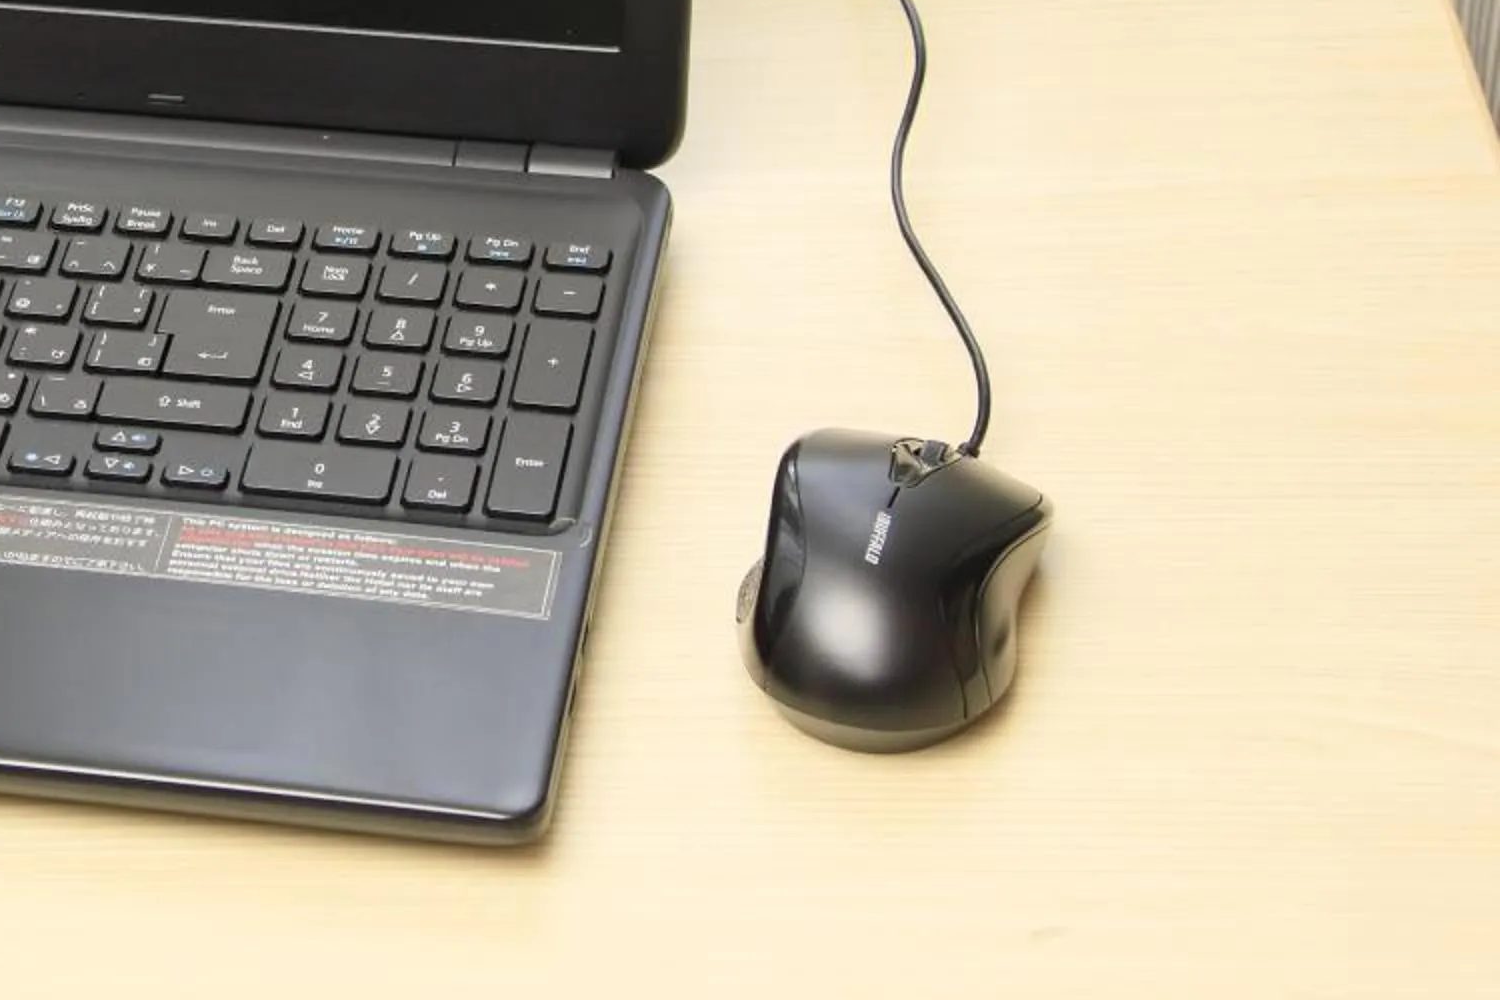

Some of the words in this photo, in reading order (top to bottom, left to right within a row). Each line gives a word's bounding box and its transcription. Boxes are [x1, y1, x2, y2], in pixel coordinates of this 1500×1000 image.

[132, 208, 161, 217] Pause
[232, 256, 258, 268] Back
[231, 262, 262, 274] Space
[208, 305, 235, 314] Enter
[319, 312, 328, 322] 7
[303, 324, 334, 333] Home
[396, 319, 406, 331] 8
[475, 326, 484, 336] 9
[302, 360, 314, 370] 4
[382, 366, 392, 376] 5
[462, 373, 472, 384] 6
[176, 399, 200, 408] Shift
[281, 419, 302, 428] End
[450, 422, 460, 432] 3
[516, 458, 544, 466] Enter
[315, 464, 324, 474] 0
[428, 490, 446, 498] Del
